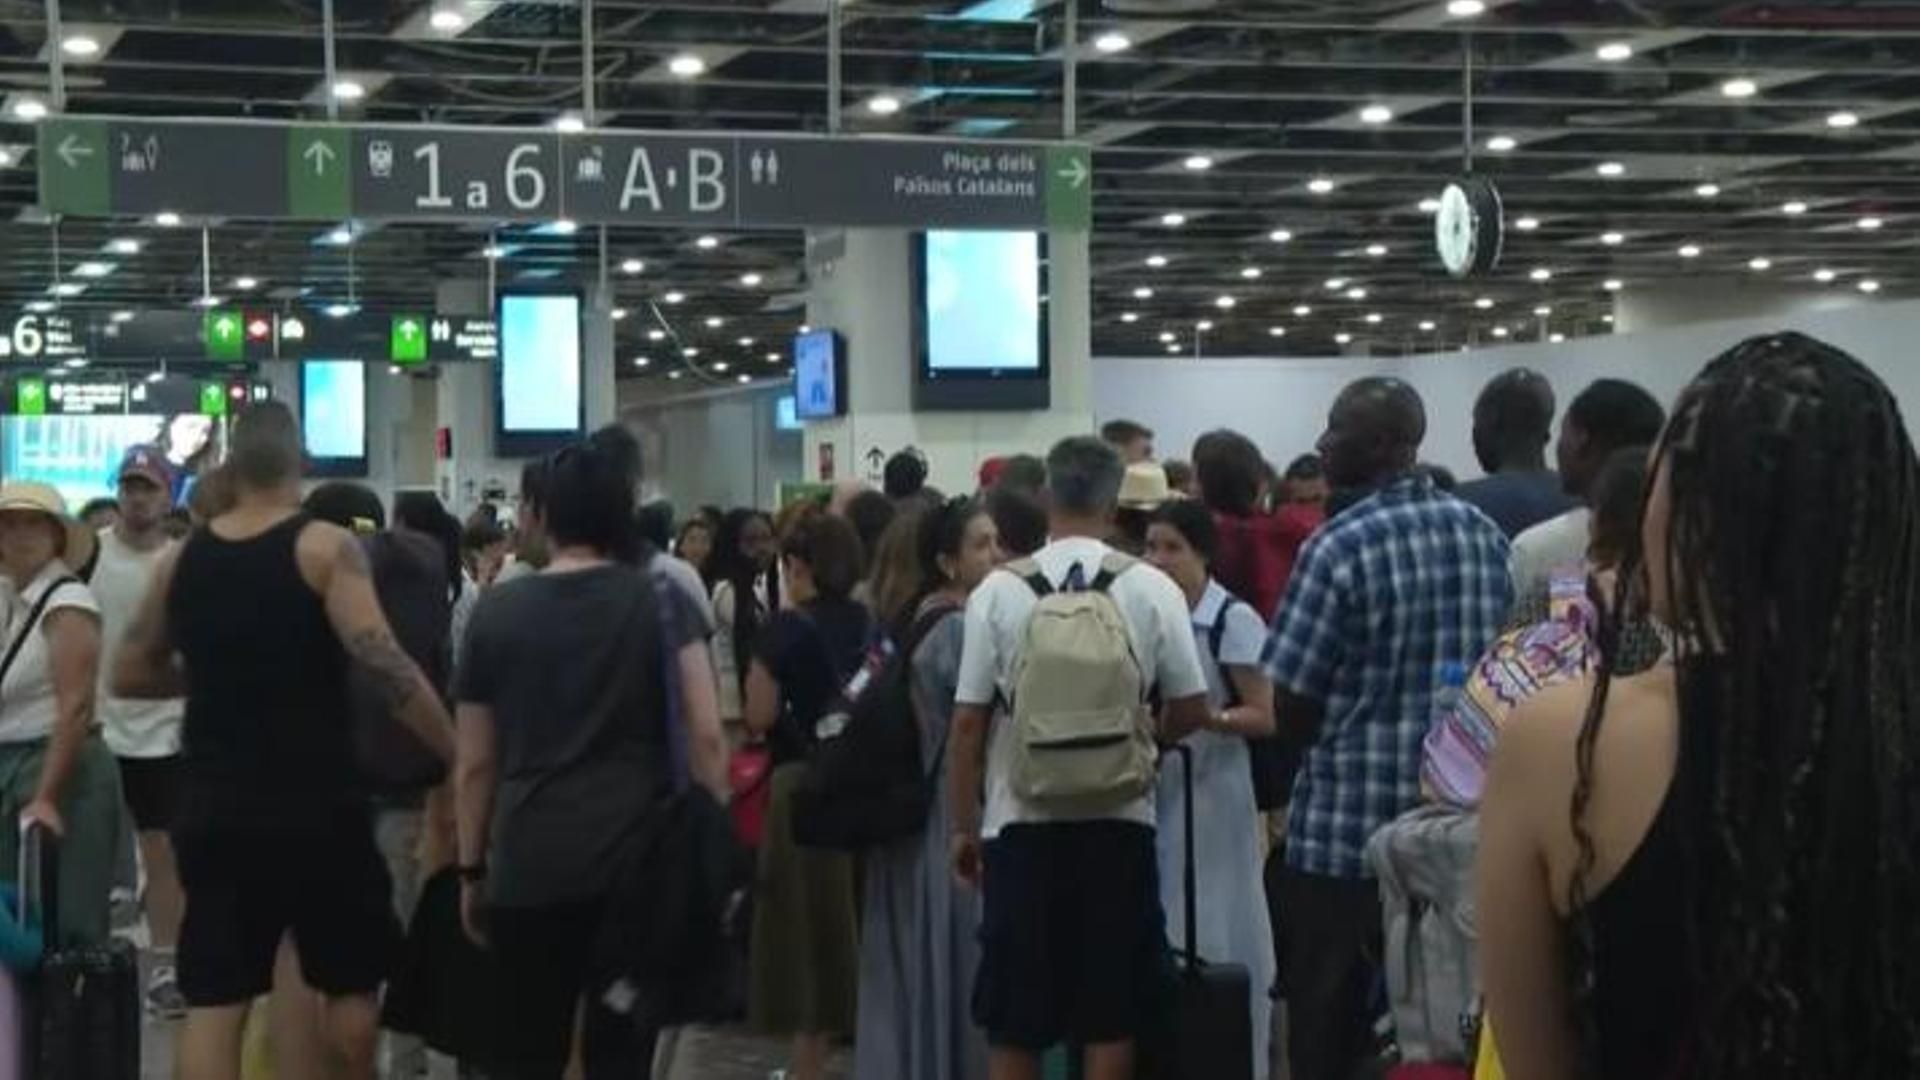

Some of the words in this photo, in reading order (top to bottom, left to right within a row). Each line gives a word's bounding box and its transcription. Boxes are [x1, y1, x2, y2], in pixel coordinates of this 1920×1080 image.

[415, 143, 452, 208] 1
[467, 181, 488, 208] a
[505, 144, 546, 210] 6
[943, 152, 991, 174] Plaça
[957, 176, 1035, 196] Catalans
[14, 315, 42, 356] 6
